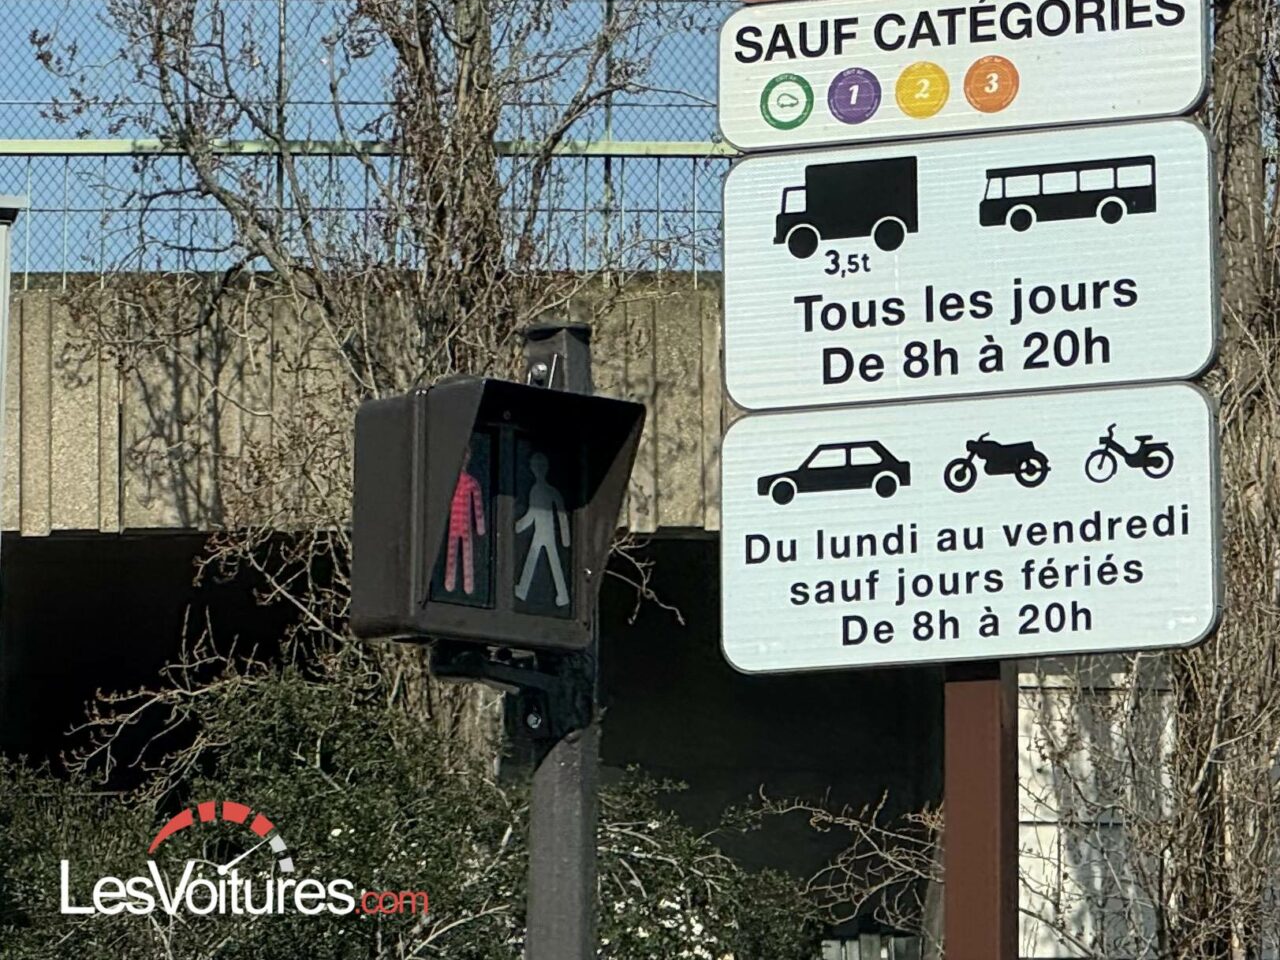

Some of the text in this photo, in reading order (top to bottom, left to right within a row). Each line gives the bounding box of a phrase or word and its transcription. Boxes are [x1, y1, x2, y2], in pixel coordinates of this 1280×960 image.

[734, 17, 859, 64] SAUF
[848, 72, 999, 105] 1 2 3
[824, 249, 871, 278] 3,5t
[793, 277, 1138, 333] Tous les jours
[822, 326, 1110, 385] De 8h à 20h
[745, 504, 1189, 565] Du lundi au vendredi
[790, 553, 1144, 606] sauf jours fériés
[842, 600, 1092, 646] De 8h à 20h
